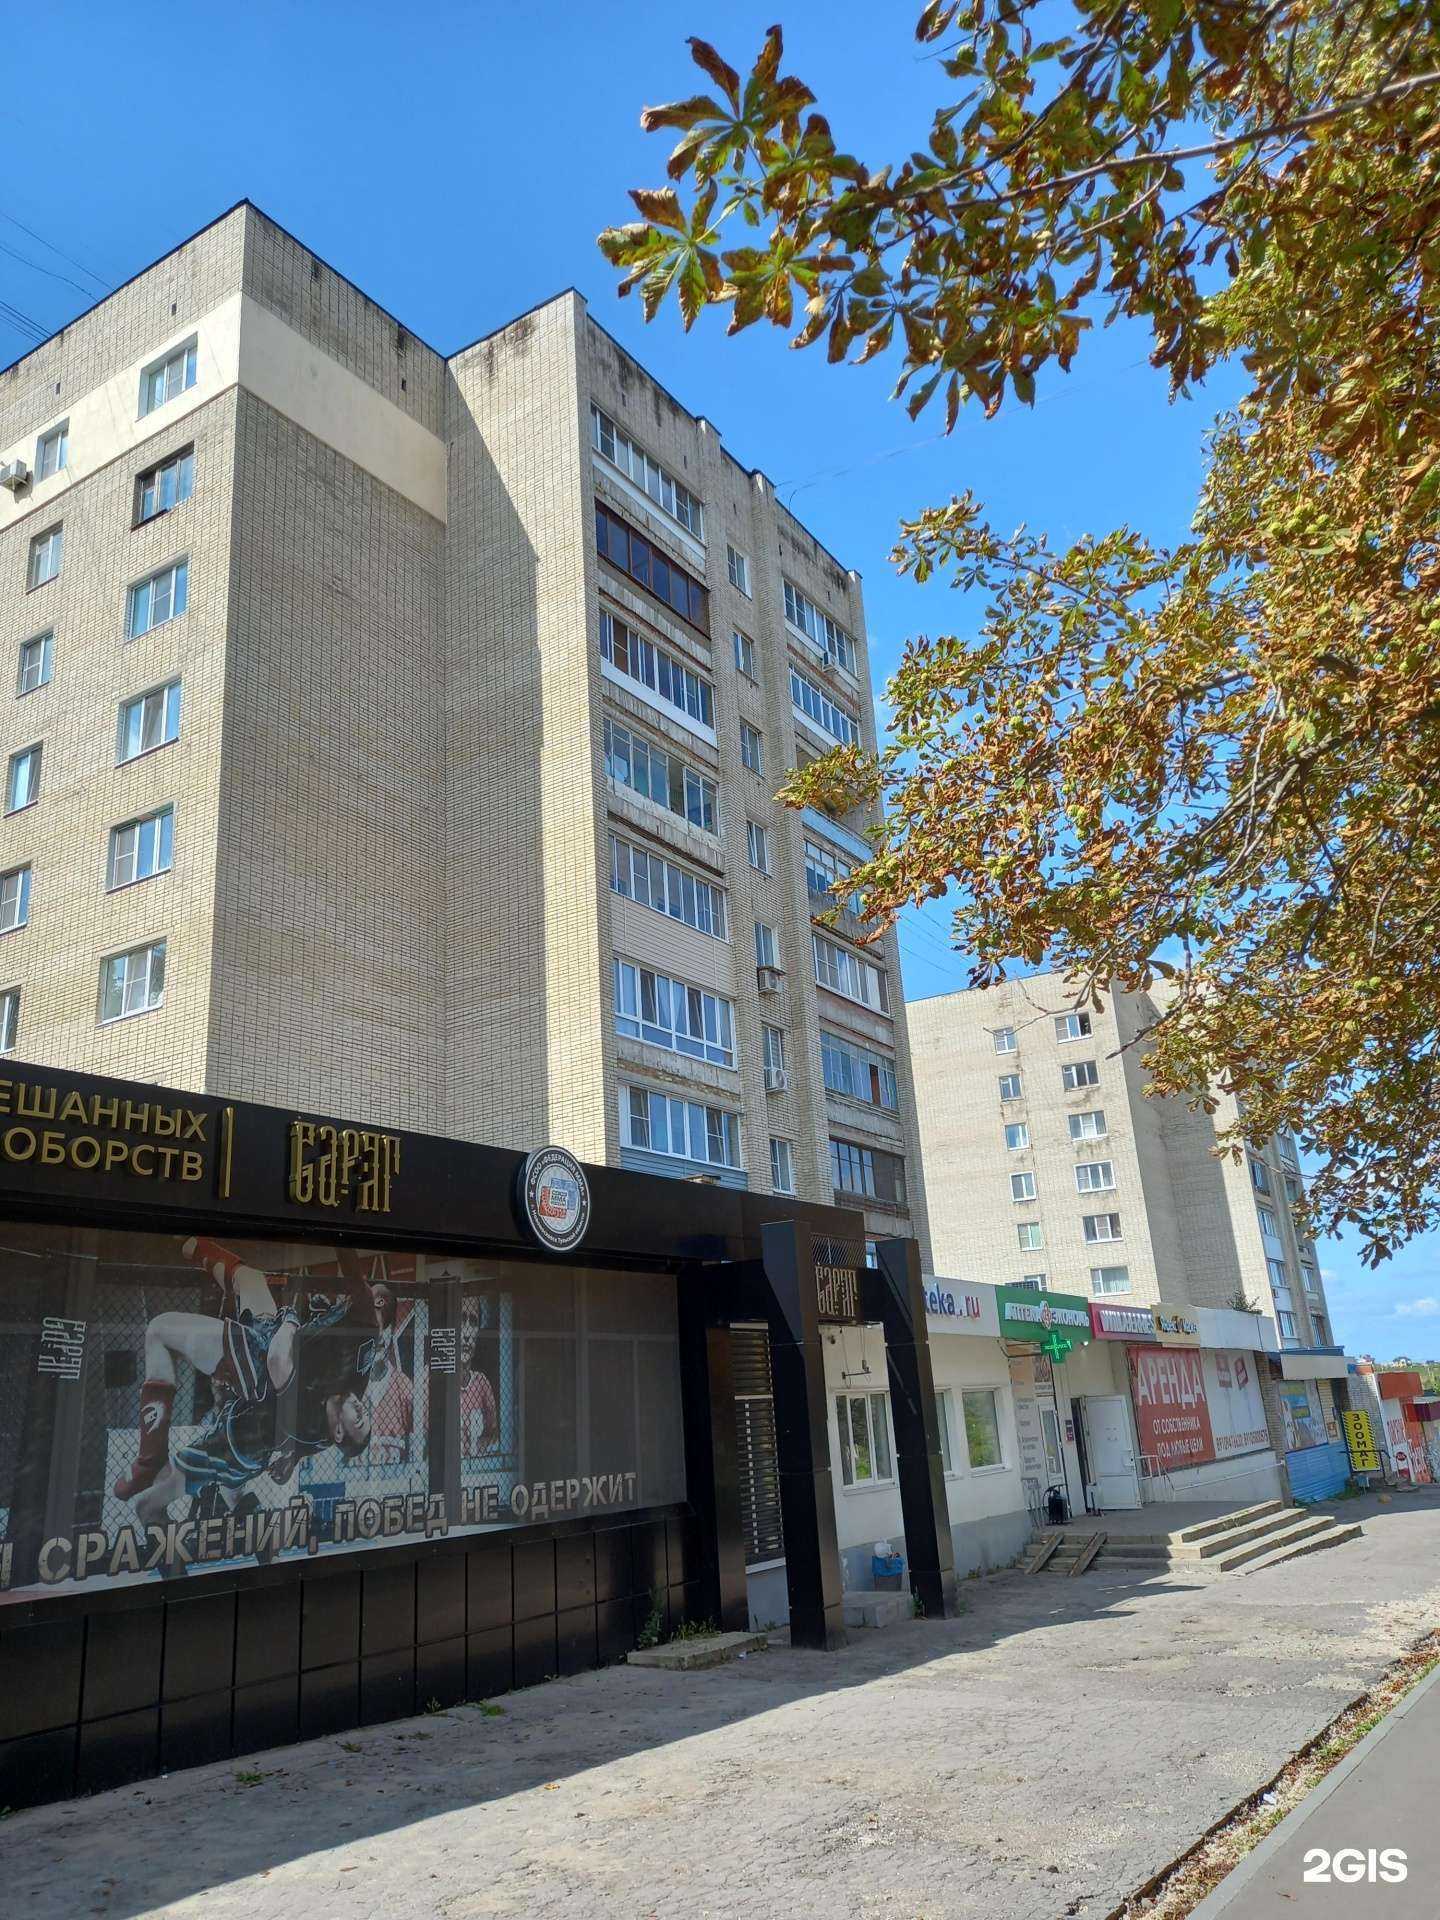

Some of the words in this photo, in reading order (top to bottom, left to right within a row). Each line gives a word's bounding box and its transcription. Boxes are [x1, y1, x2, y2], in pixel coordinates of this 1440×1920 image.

[3, 1126, 204, 1182] ОБОРСТВ
[1137, 1356, 1206, 1410] АРЕНДА
[1152, 1416, 1162, 1435] ОТ
[1352, 1413, 1369, 1467] ЗООМАГ
[37, 1495, 319, 1586] СРАЖЕНИЙ,
[332, 1492, 449, 1544] ПОБЕД
[461, 1484, 502, 1523] НЕ
[511, 1472, 638, 1522] ОДЕРЖИТ
